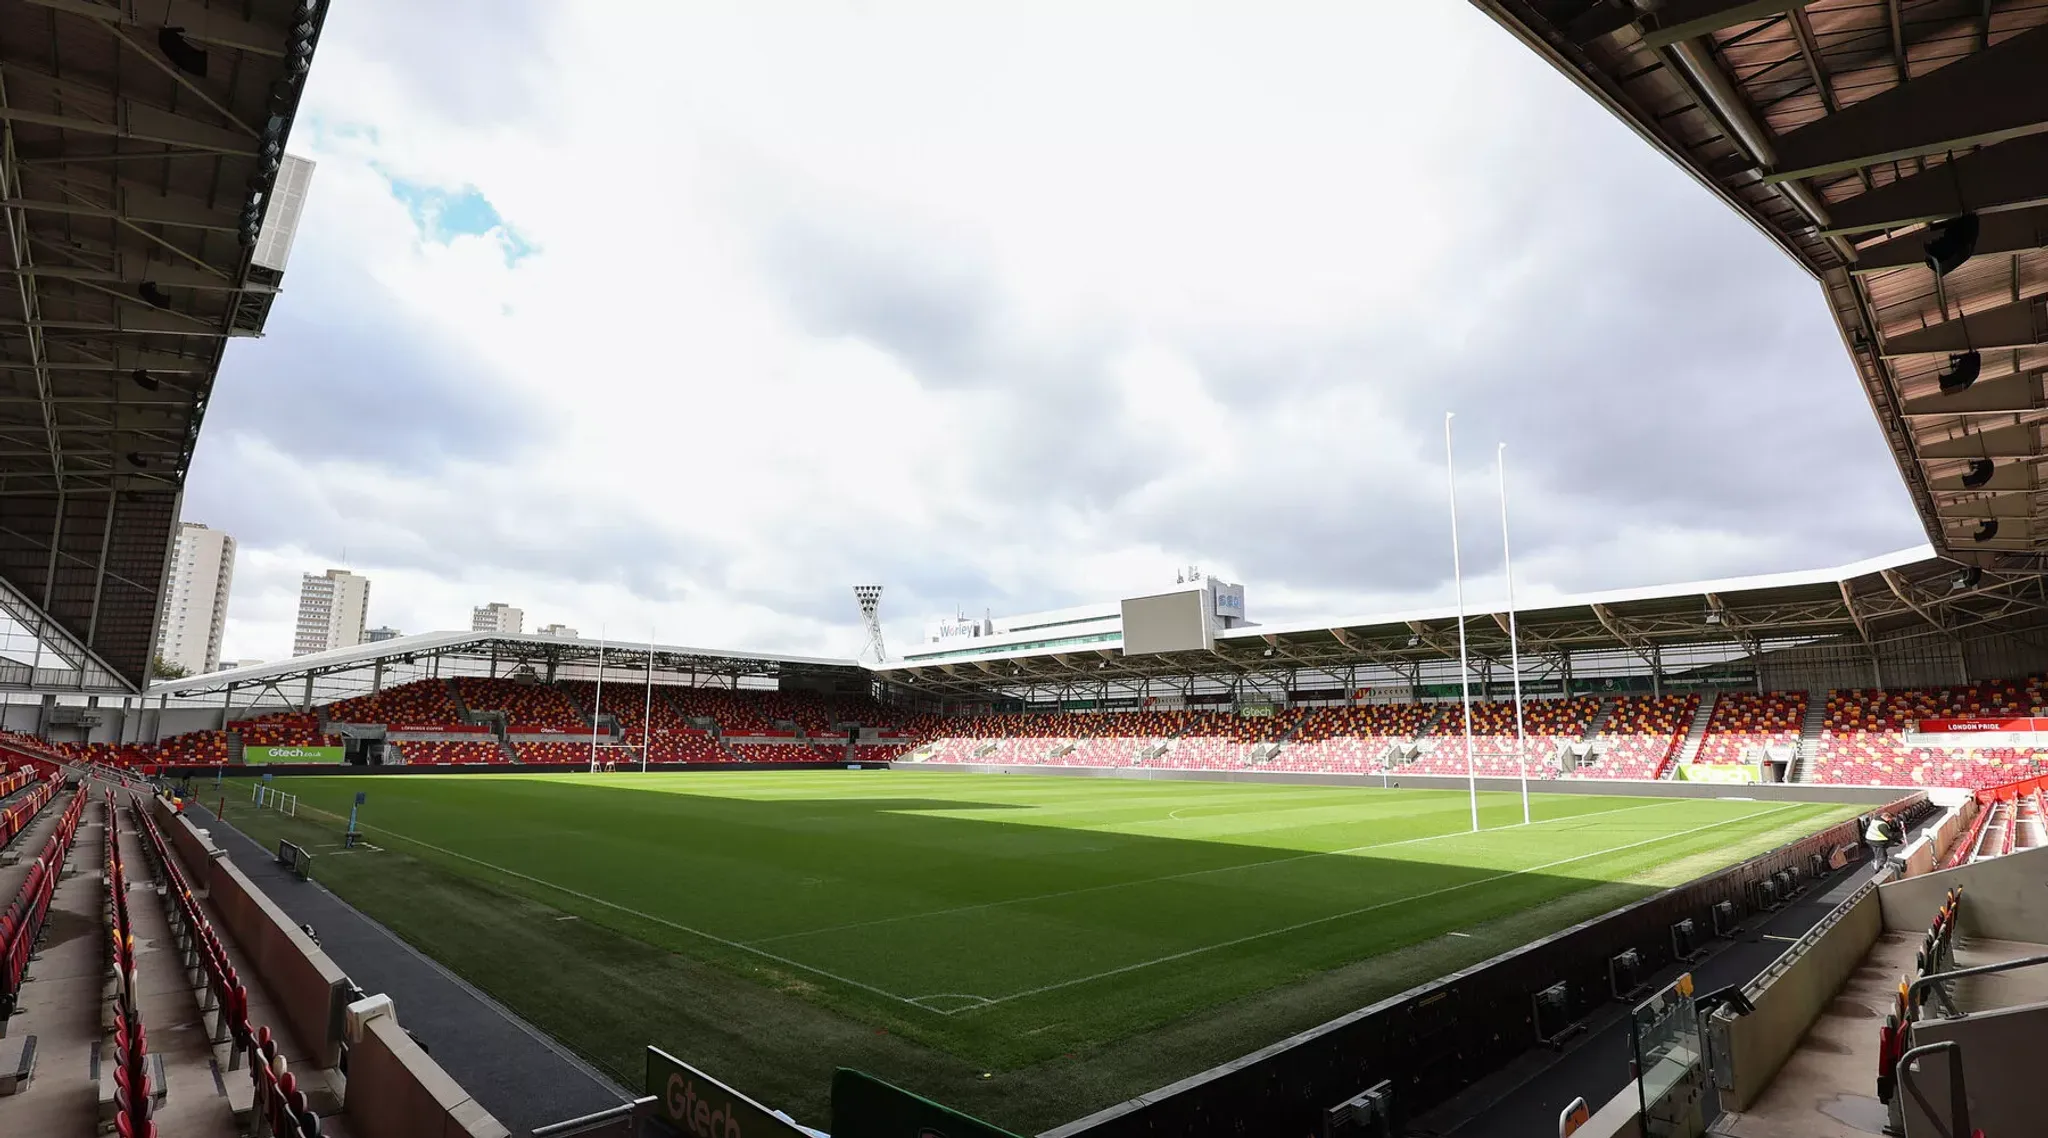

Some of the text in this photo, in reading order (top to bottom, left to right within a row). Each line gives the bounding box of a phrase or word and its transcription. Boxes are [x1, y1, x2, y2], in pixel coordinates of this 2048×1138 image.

[940, 624, 973, 639] Worley
[1242, 706, 1272, 717] Gtech
[667, 1072, 742, 1138] Gtech
